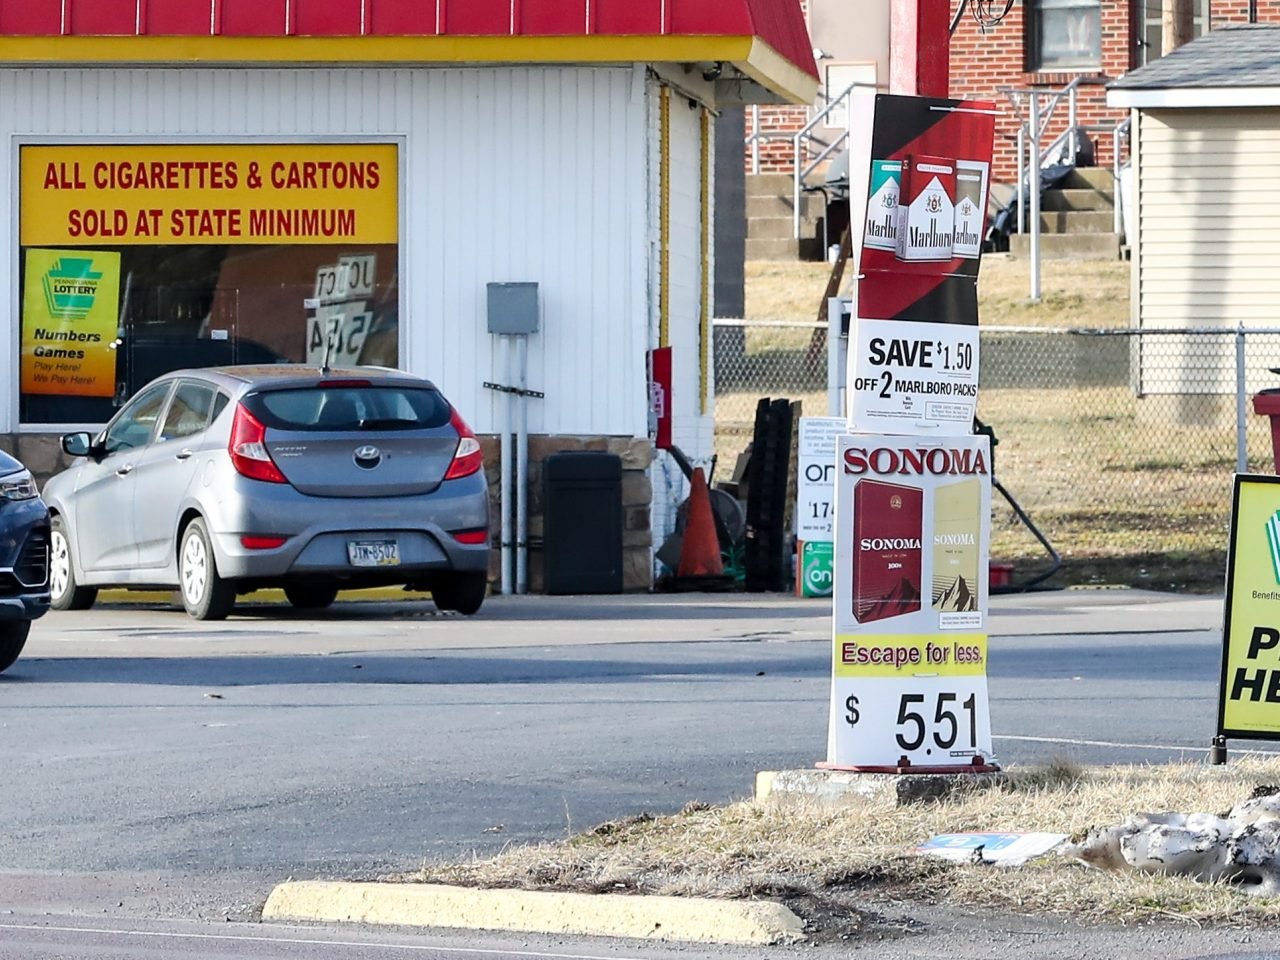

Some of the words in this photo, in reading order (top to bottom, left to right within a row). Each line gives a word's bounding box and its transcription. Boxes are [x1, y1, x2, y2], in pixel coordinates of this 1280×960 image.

[43, 162, 86, 190] ALL
[93, 161, 239, 190] CIGARETTES
[246, 162, 263, 189] &
[270, 161, 380, 189] CARTONS
[67, 210, 128, 237] SOLD
[134, 210, 163, 237] AT
[170, 209, 241, 237] STATE
[249, 209, 356, 237] MINIMUM
[909, 218, 951, 247] Marlboro
[53, 285, 97, 295] LOTTERY
[33, 328, 101, 342] Numbers
[33, 346, 85, 359] Games
[34, 361, 53, 371] Play
[869, 337, 933, 368] SAVE
[51, 374, 67, 384] Pay
[854, 378, 878, 391] OFF
[879, 371, 893, 398] 2
[895, 380, 952, 395] MARLBORO
[953, 383, 977, 397] PACKS
[843, 447, 987, 475] SONOMA
[861, 538, 921, 551] SONOMA
[934, 534, 975, 545] SONOMA
[841, 642, 920, 669] Escape
[925, 641, 949, 663] for
[953, 642, 983, 664] less.
[895, 692, 976, 755] 5.51
